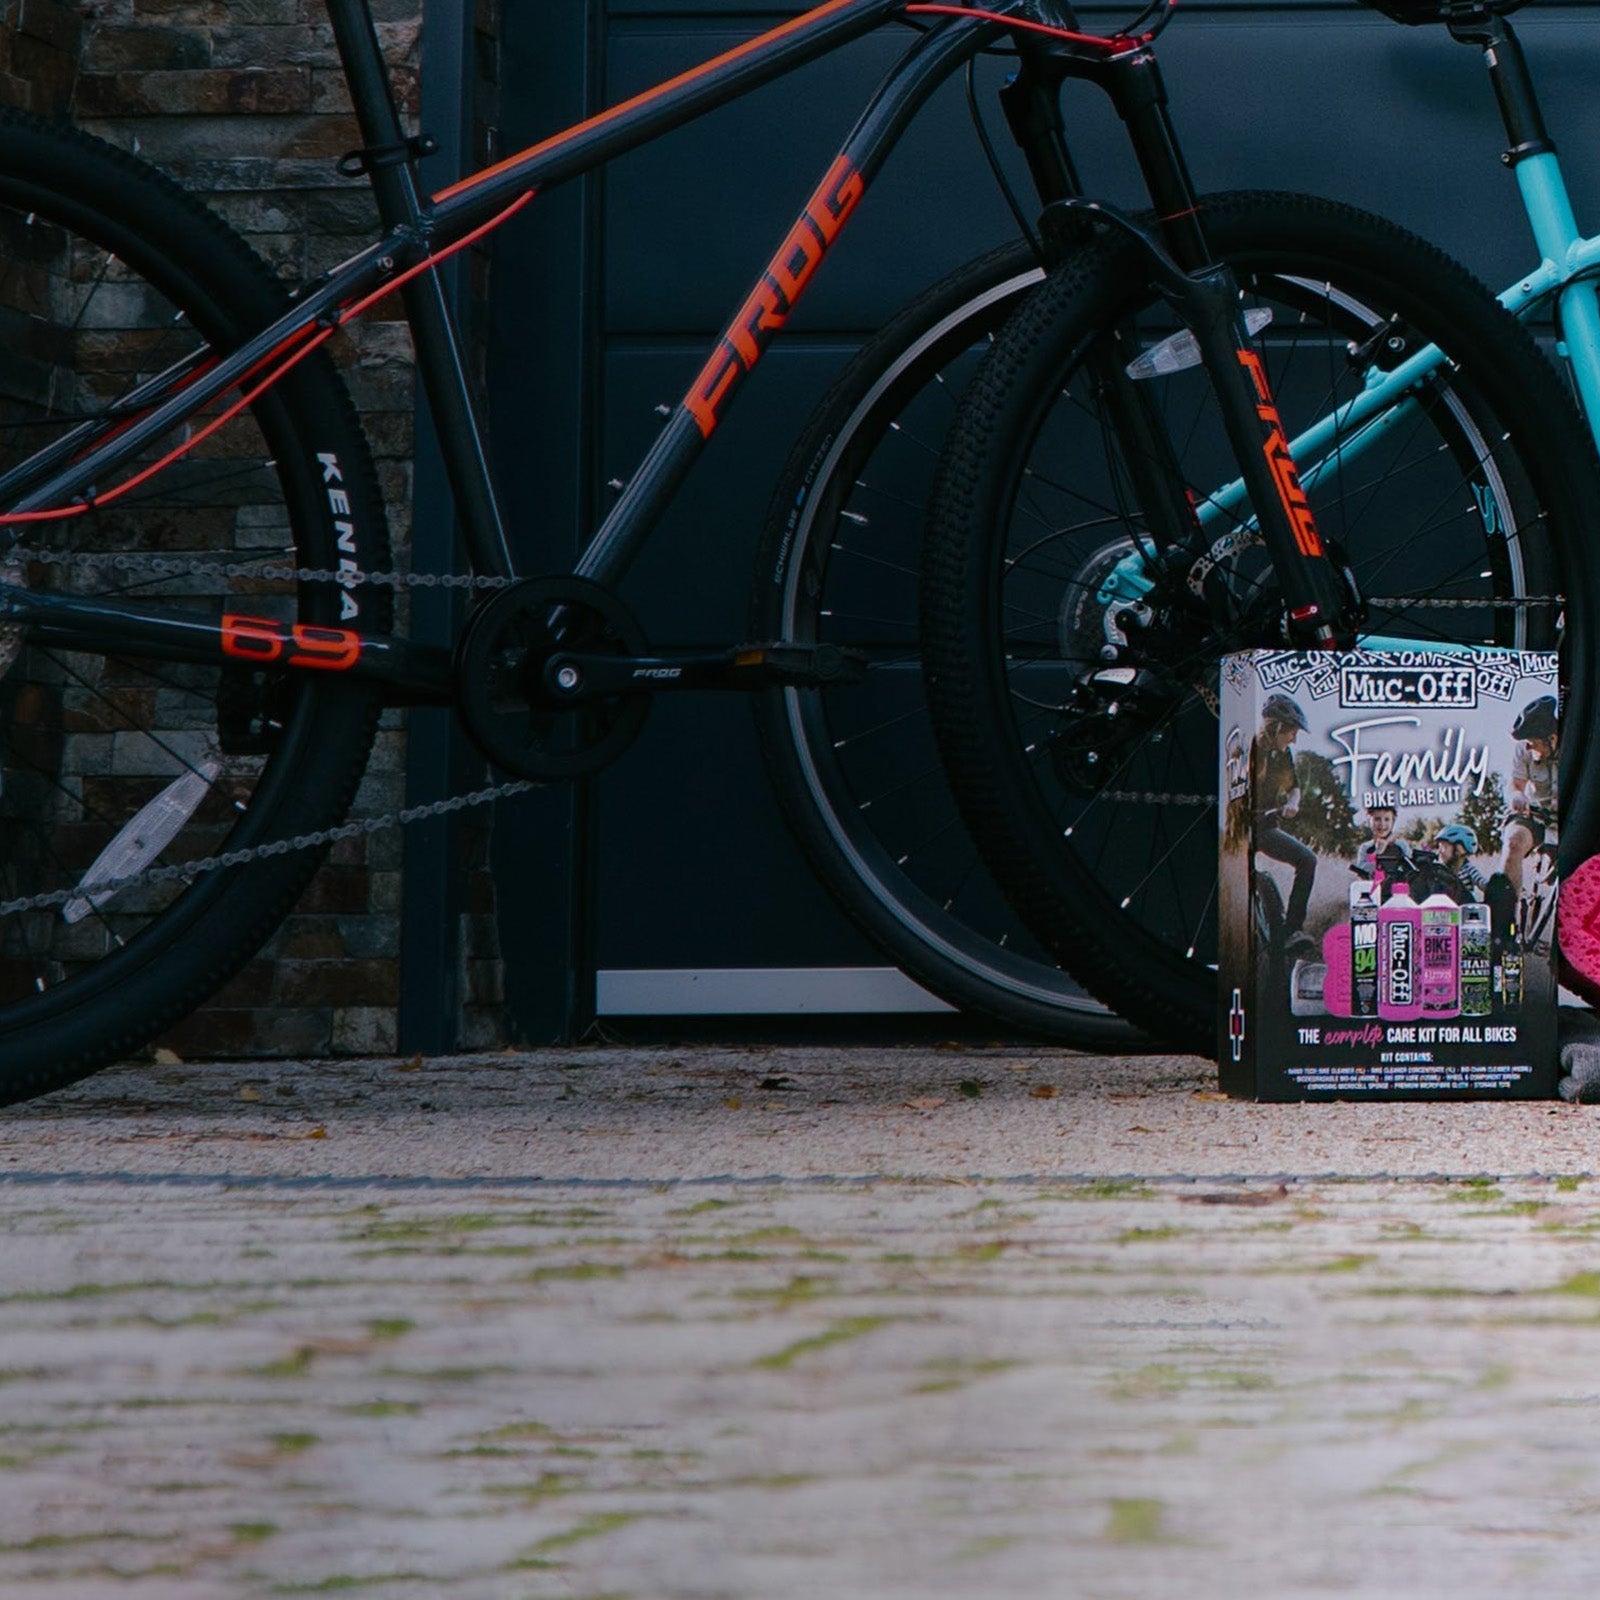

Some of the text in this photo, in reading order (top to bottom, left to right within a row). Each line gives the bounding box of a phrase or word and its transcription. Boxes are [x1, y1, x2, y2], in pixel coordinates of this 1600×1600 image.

[684, 154, 864, 439] FROG
[1238, 349, 1323, 558] FROG
[222, 614, 360, 671] 69
[632, 667, 683, 679] FROG
[1263, 650, 1322, 682] Muc-O
[1349, 673, 1470, 702] Muc-Off
[1330, 715, 1489, 797] Family
[1364, 786, 1460, 807] BIKE CARE KIT
[1424, 938, 1452, 953] BIKE
[1391, 926, 1409, 1001] Muc-Off
[1298, 1022, 1517, 1049] THE complete CARE KIT FOR ALL BIKES
[1380, 1052, 1394, 1063] KIT
